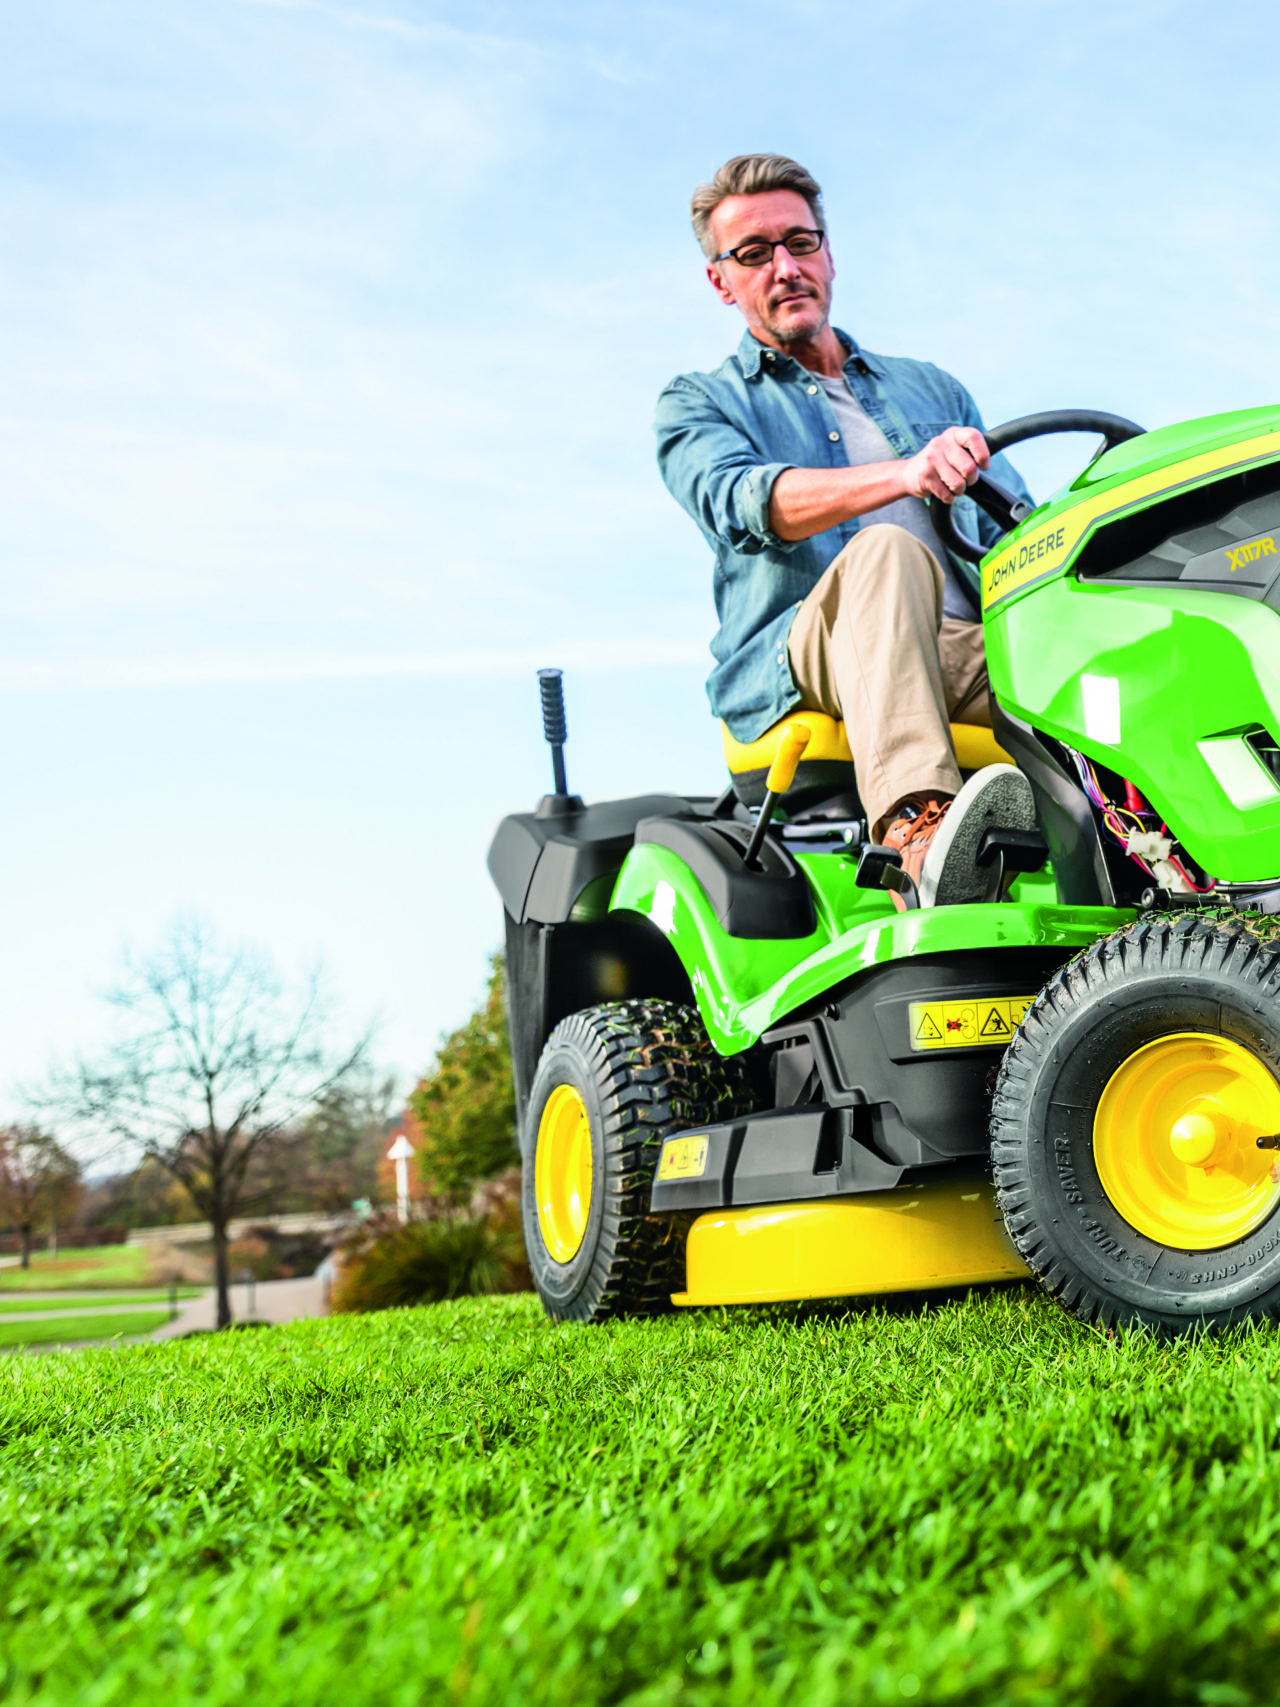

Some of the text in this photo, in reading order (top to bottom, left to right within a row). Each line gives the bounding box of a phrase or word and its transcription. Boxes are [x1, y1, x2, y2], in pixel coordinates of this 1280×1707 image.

[988, 527, 1064, 592] JOHN DEERE
[1224, 536, 1279, 572] X117R
[1054, 1137, 1082, 1205] SAVER
